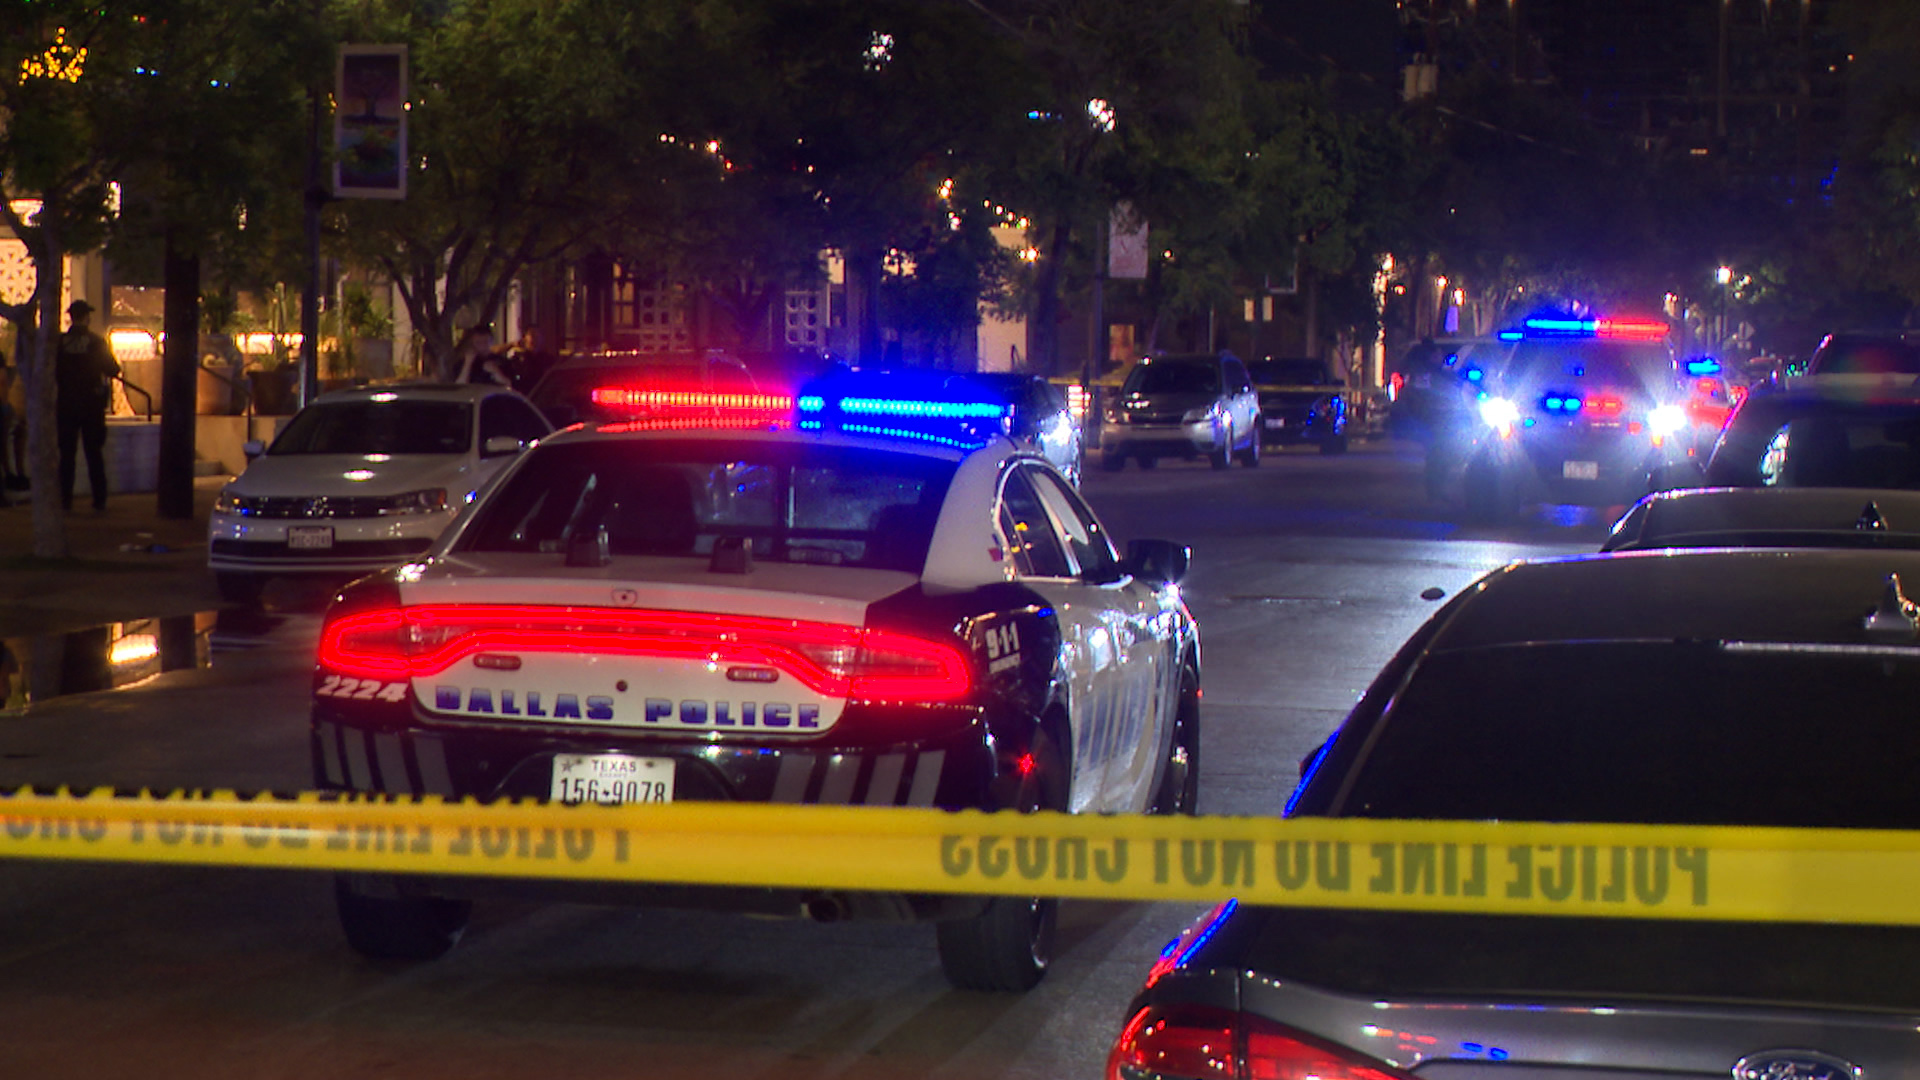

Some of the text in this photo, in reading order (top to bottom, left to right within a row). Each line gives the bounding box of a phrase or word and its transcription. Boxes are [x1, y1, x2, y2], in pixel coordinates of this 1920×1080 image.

[316, 675, 409, 702] 2224
[435, 685, 820, 728] DALLAS POLICE
[591, 759, 637, 772] TEXAS
